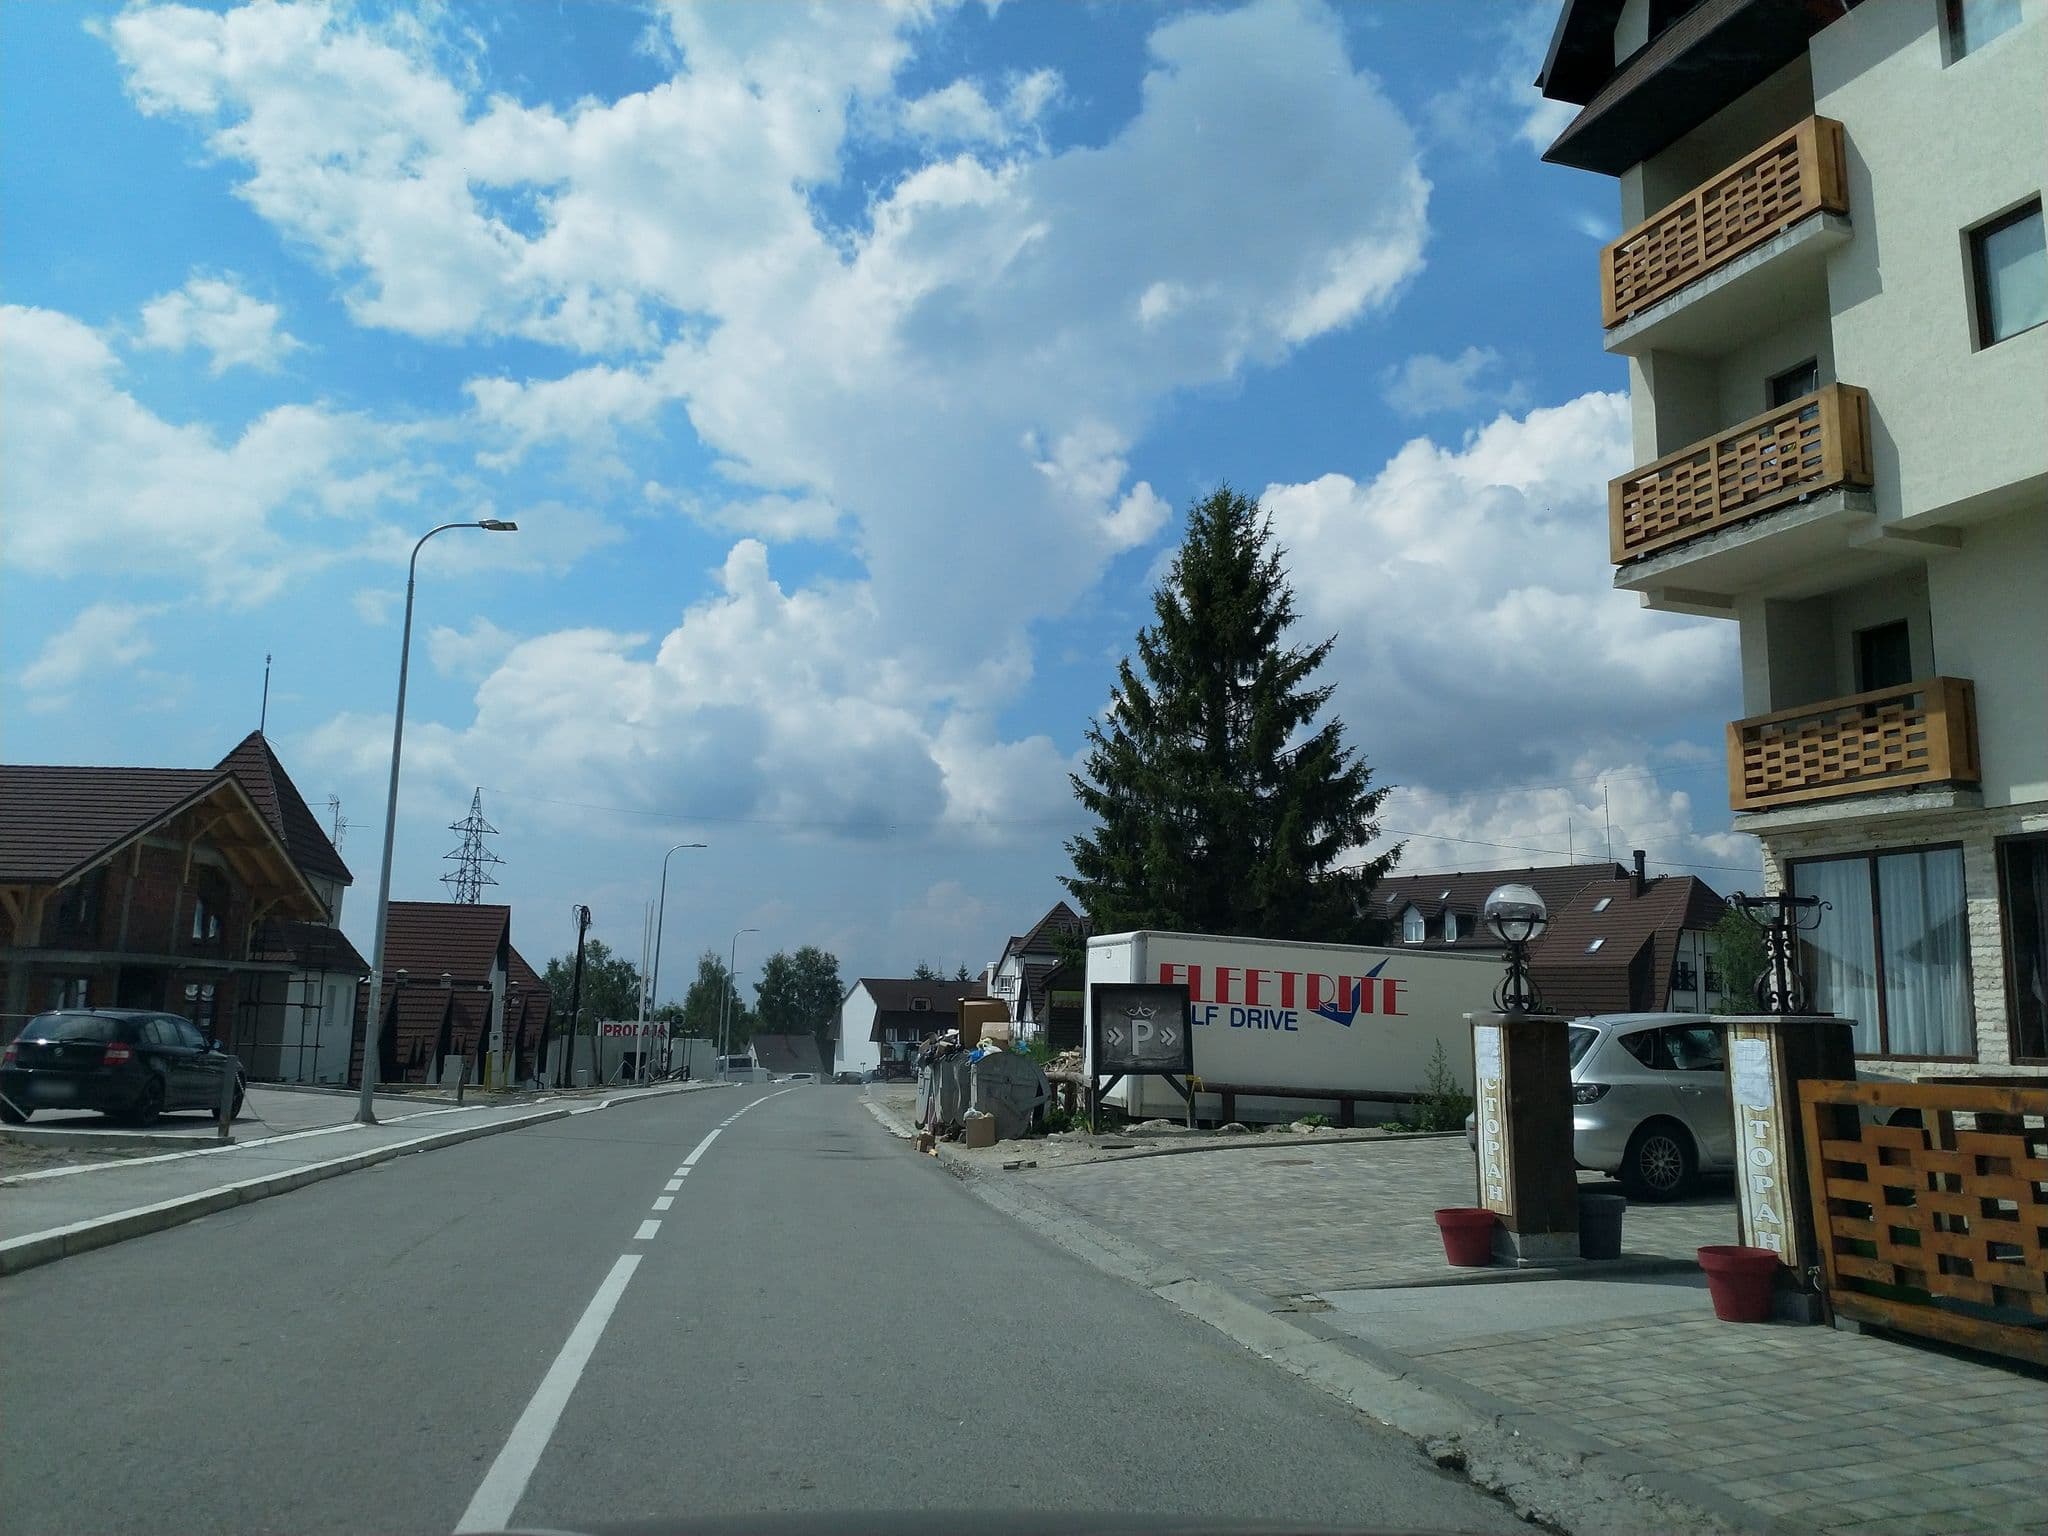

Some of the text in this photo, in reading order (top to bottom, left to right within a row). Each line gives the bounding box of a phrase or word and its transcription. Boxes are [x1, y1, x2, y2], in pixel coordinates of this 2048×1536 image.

[1191, 1004, 1298, 1031] LF DRIVE
[1131, 1020, 1154, 1056] P
[1484, 1079, 1504, 1203] СТОРАН
